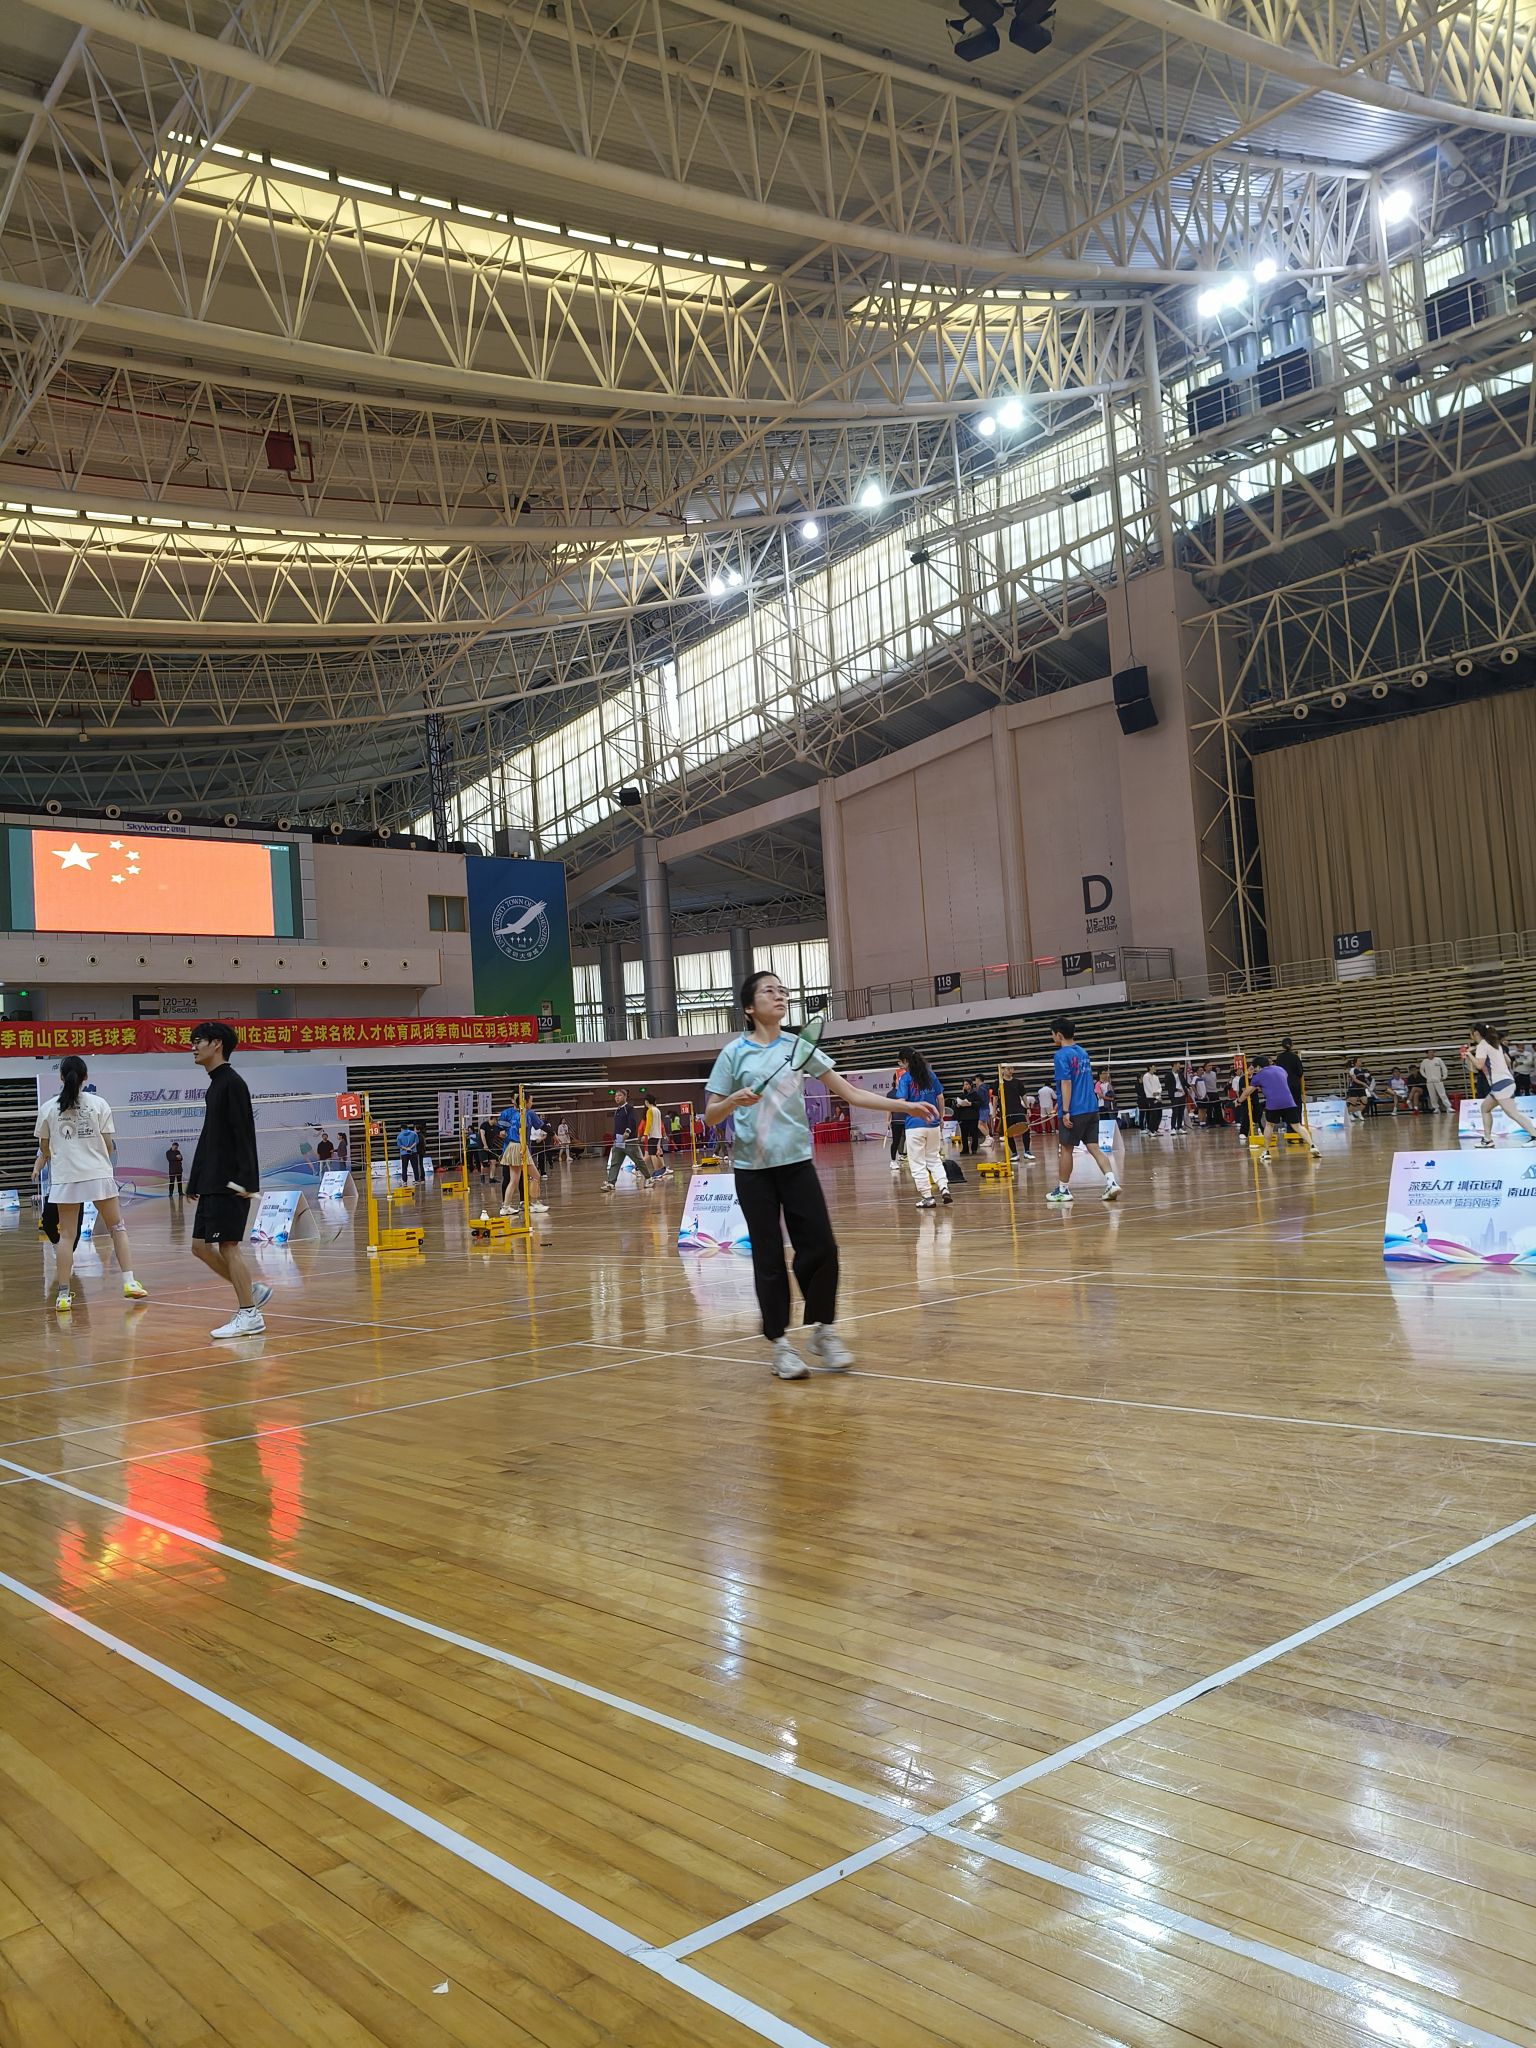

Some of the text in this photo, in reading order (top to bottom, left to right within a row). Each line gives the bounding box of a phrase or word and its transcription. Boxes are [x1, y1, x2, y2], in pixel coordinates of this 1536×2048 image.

[1082, 875, 1113, 914] D
[505, 898, 524, 908] TOWN
[1086, 915, 1116, 927] 115-119
[1337, 935, 1360, 950] 116
[1064, 955, 1081, 969] 117
[937, 975, 952, 987] 118
[163, 997, 198, 1006] 120-124
[807, 996, 820, 1007] 119
[537, 1017, 553, 1027] 120
[340, 1104, 358, 1118] 15
[369, 1127, 379, 1135] 19
[1408, 1179, 1503, 1192] 深爱人才 圳在运动
